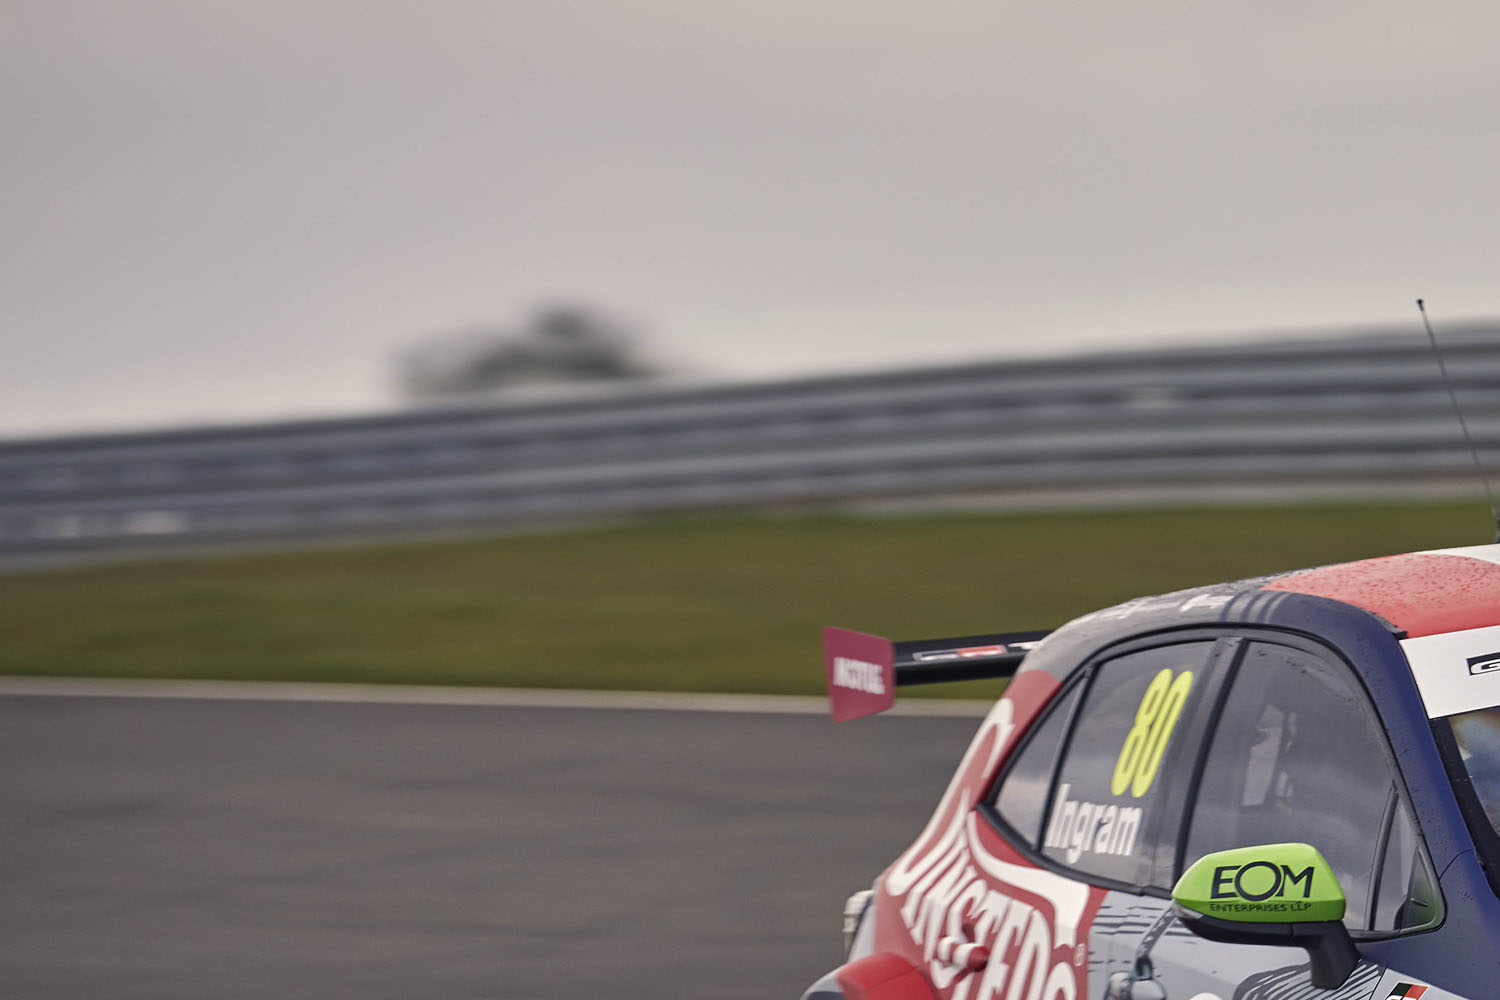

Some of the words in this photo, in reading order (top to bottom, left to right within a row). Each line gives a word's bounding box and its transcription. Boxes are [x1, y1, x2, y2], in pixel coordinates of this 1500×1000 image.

[1111, 668, 1194, 798] 80
[1045, 783, 1143, 864] Ingram
[1209, 902, 1288, 912] ENTERPRISES
[1210, 861, 1315, 902] EOM
